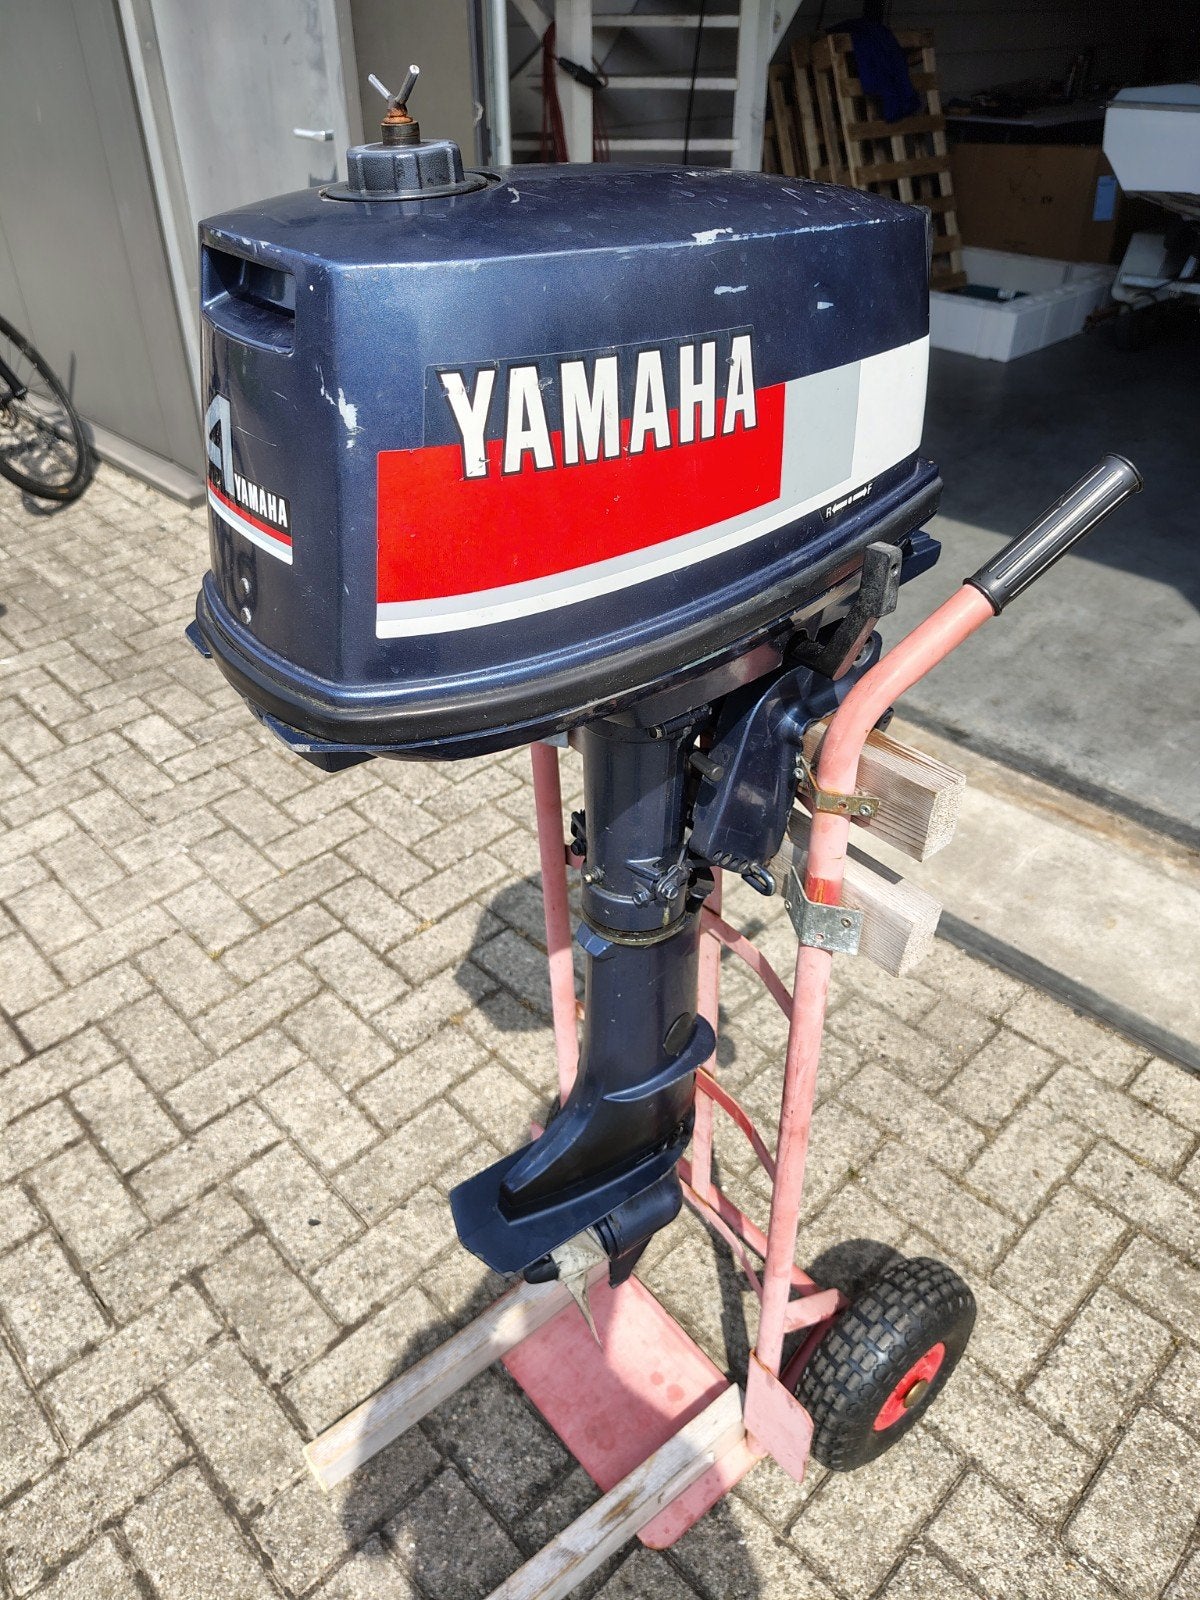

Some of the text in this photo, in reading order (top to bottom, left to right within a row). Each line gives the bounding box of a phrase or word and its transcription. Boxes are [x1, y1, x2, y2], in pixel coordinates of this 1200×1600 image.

[205, 393, 236, 497] 4
[439, 335, 756, 478] YAMAHA
[234, 473, 289, 529] YAMAHA
[826, 482, 874, 519] R F
